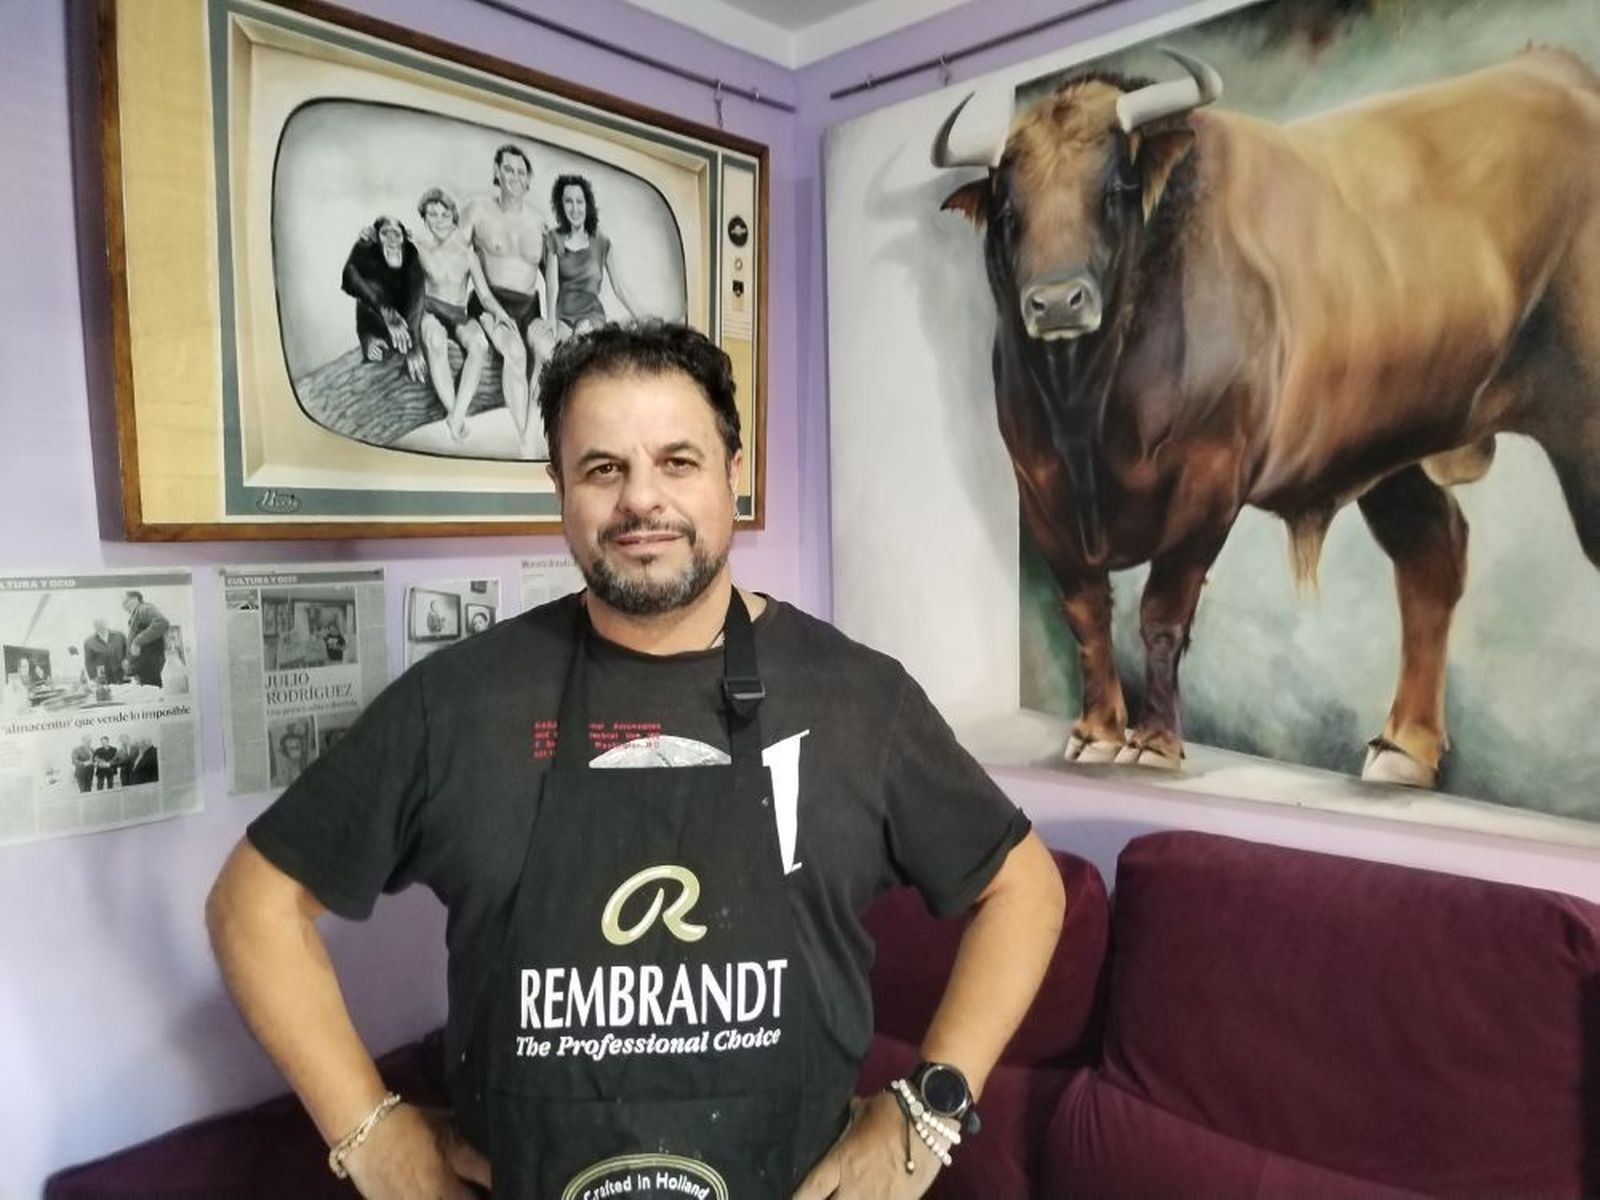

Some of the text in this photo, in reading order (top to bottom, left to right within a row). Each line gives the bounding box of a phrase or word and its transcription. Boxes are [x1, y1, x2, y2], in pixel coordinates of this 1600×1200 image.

[265, 673, 310, 690] JULIO
[266, 683, 353, 705] RODRÍGUEZ
[74, 717, 95, 729] que
[97, 713, 129, 724] vende
[130, 710, 140, 721] lo
[141, 705, 191, 721] imposible
[519, 959, 789, 1029] REMBRANDT
[515, 1027, 782, 1061] The Professional Choice
[583, 1175, 633, 1200] Crafted
[656, 1171, 710, 1200] Holland
